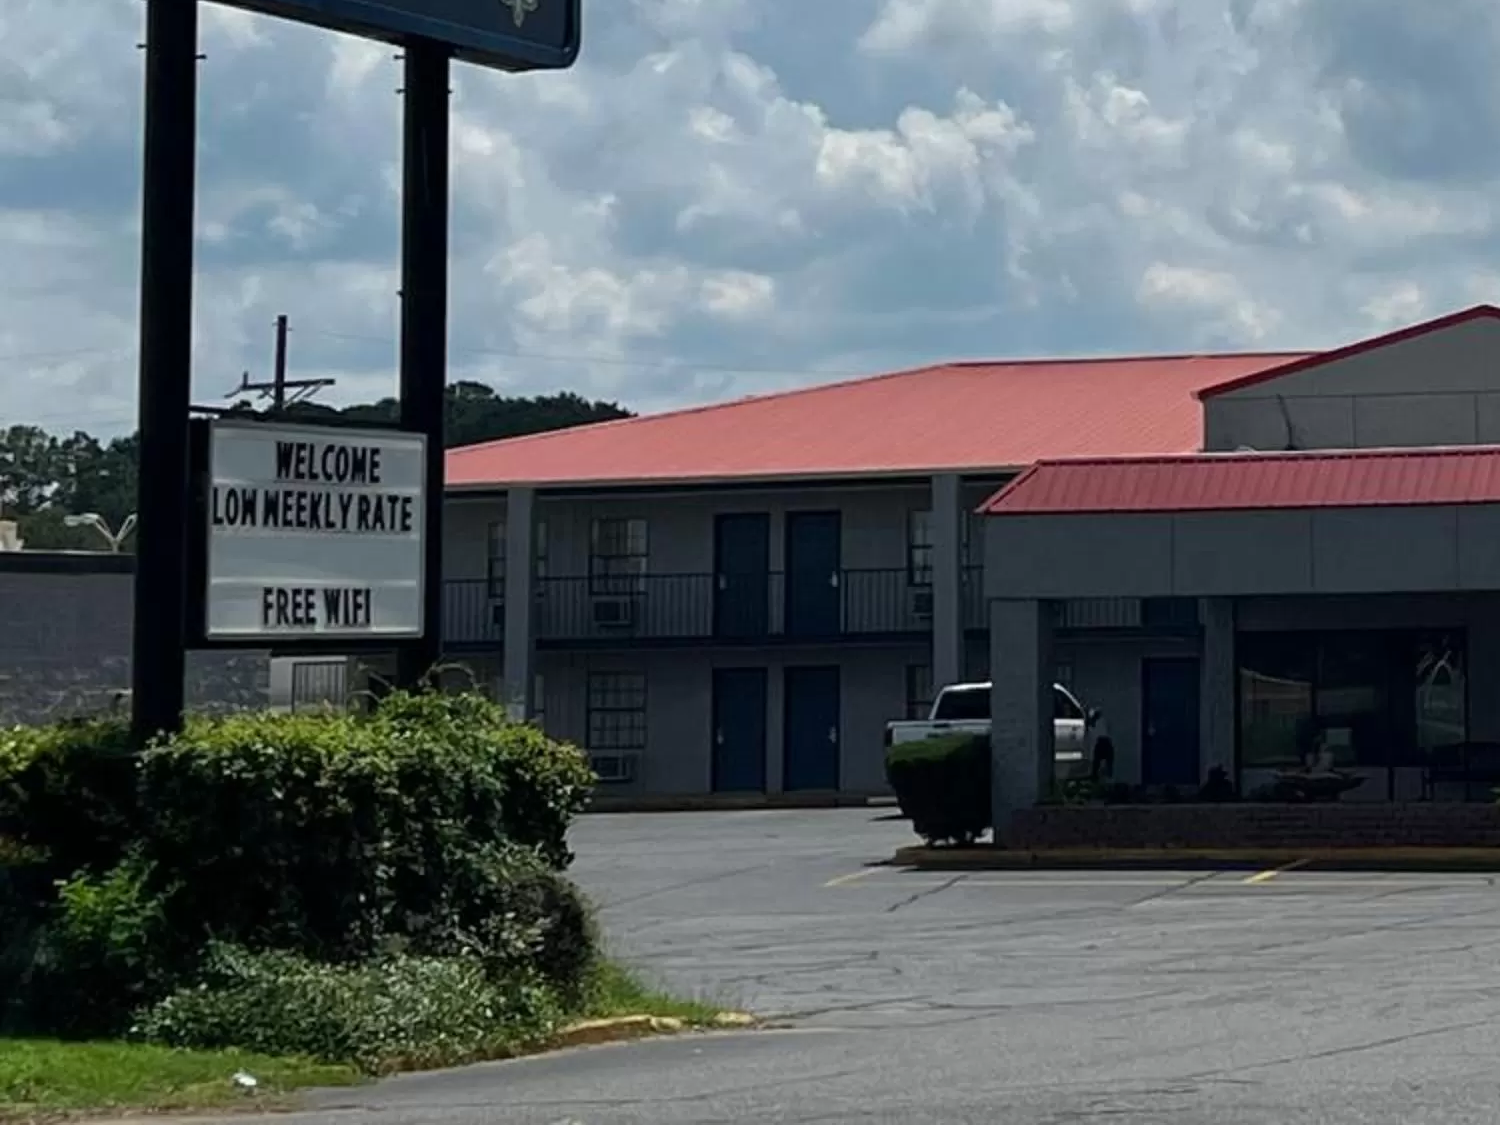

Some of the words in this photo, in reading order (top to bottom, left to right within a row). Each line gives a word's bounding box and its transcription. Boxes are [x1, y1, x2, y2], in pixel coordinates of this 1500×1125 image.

[276, 441, 381, 483] WELCOME
[213, 486, 257, 527] LOW
[263, 489, 352, 530] WEEKLY
[357, 494, 412, 532] RATE
[263, 586, 316, 625] FREE
[323, 587, 371, 625] WIFI
